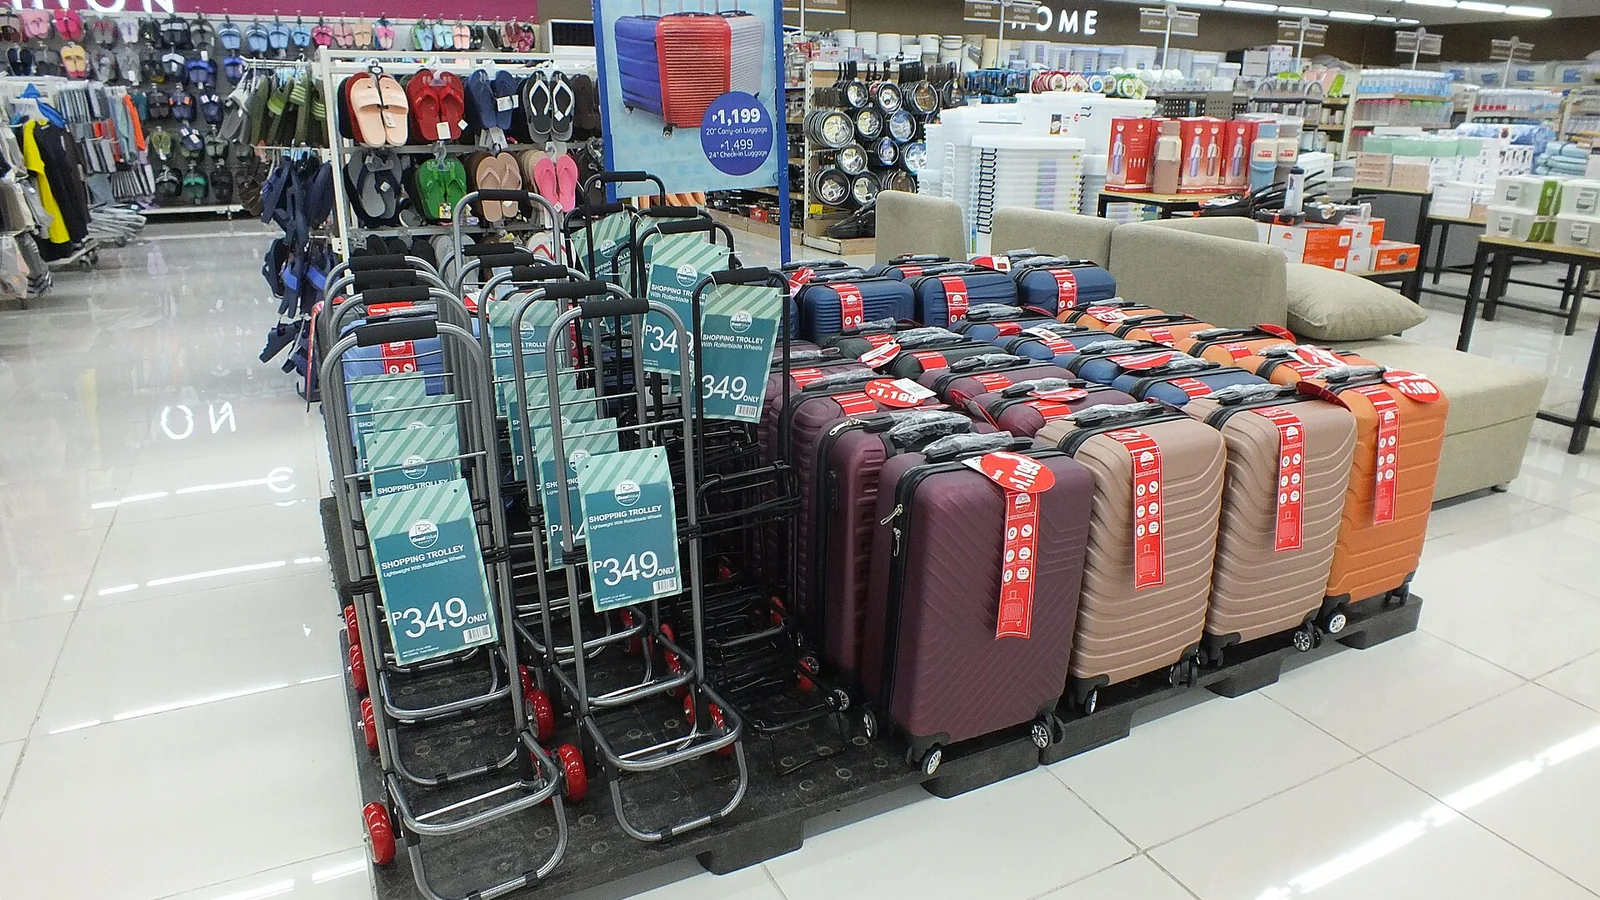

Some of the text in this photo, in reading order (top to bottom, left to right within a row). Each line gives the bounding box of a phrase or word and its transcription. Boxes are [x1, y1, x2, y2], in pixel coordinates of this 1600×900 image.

[1011, 6, 1099, 35] OME
[717, 127, 743, 135] Carry-on
[743, 126, 768, 135] Luggage
[719, 150, 744, 158] Check-in
[744, 149, 768, 158] Luggage
[651, 283, 682, 295] SHOPPING
[702, 333, 765, 345] SHOPPING TROLLEY
[713, 341, 743, 349] Rollerblade
[743, 343, 763, 351] Wheels
[743, 394, 760, 403] ONLY
[376, 483, 416, 495] SHOPPING
[588, 504, 663, 523] SHOPPING TROLLEY
[589, 522, 614, 530] Lightweight
[623, 516, 647, 525] Rollerblade
[646, 513, 663, 521] Wheels
[381, 544, 465, 570] SHOPPING TROLLEY
[383, 568, 411, 578] Lightweight
[422, 558, 449, 570] Rollerblade
[448, 554, 467, 563] Wheels
[657, 566, 675, 577] ONLY
[467, 612, 488, 624] ONLY
